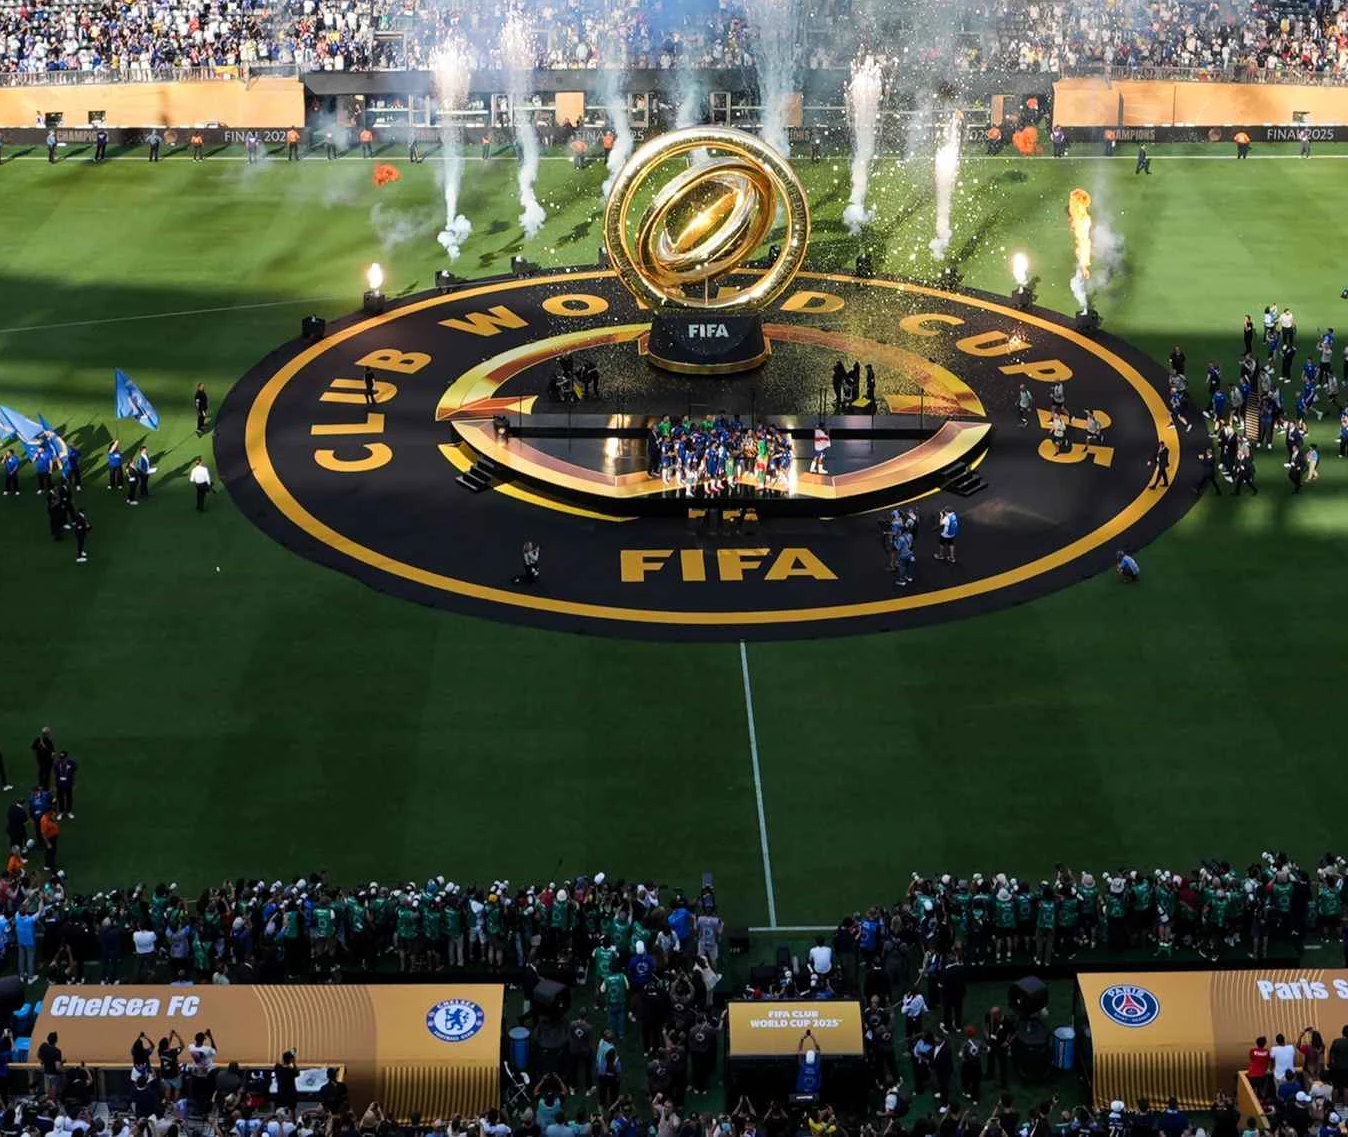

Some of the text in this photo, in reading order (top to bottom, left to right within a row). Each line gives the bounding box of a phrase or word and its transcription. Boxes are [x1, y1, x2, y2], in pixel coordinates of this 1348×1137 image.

[264, 130, 286, 142] 202
[1116, 129, 1155, 141] AMPIONS
[688, 324, 729, 338] FIFA
[310, 348, 433, 472] CLUB
[438, 291, 845, 337] WOD
[899, 313, 1074, 383] CUP
[620, 548, 839, 583] FIFA
[1107, 986, 1145, 997] PARIS
[1257, 978, 1329, 1000] Paris
[50, 995, 200, 1017] Chelsea FC
[437, 999, 475, 1009] CHELSEA
[768, 1010, 819, 1018] FIFA CLUB
[750, 1019, 788, 1028] WORLD
[789, 1019, 811, 1028] CUP
